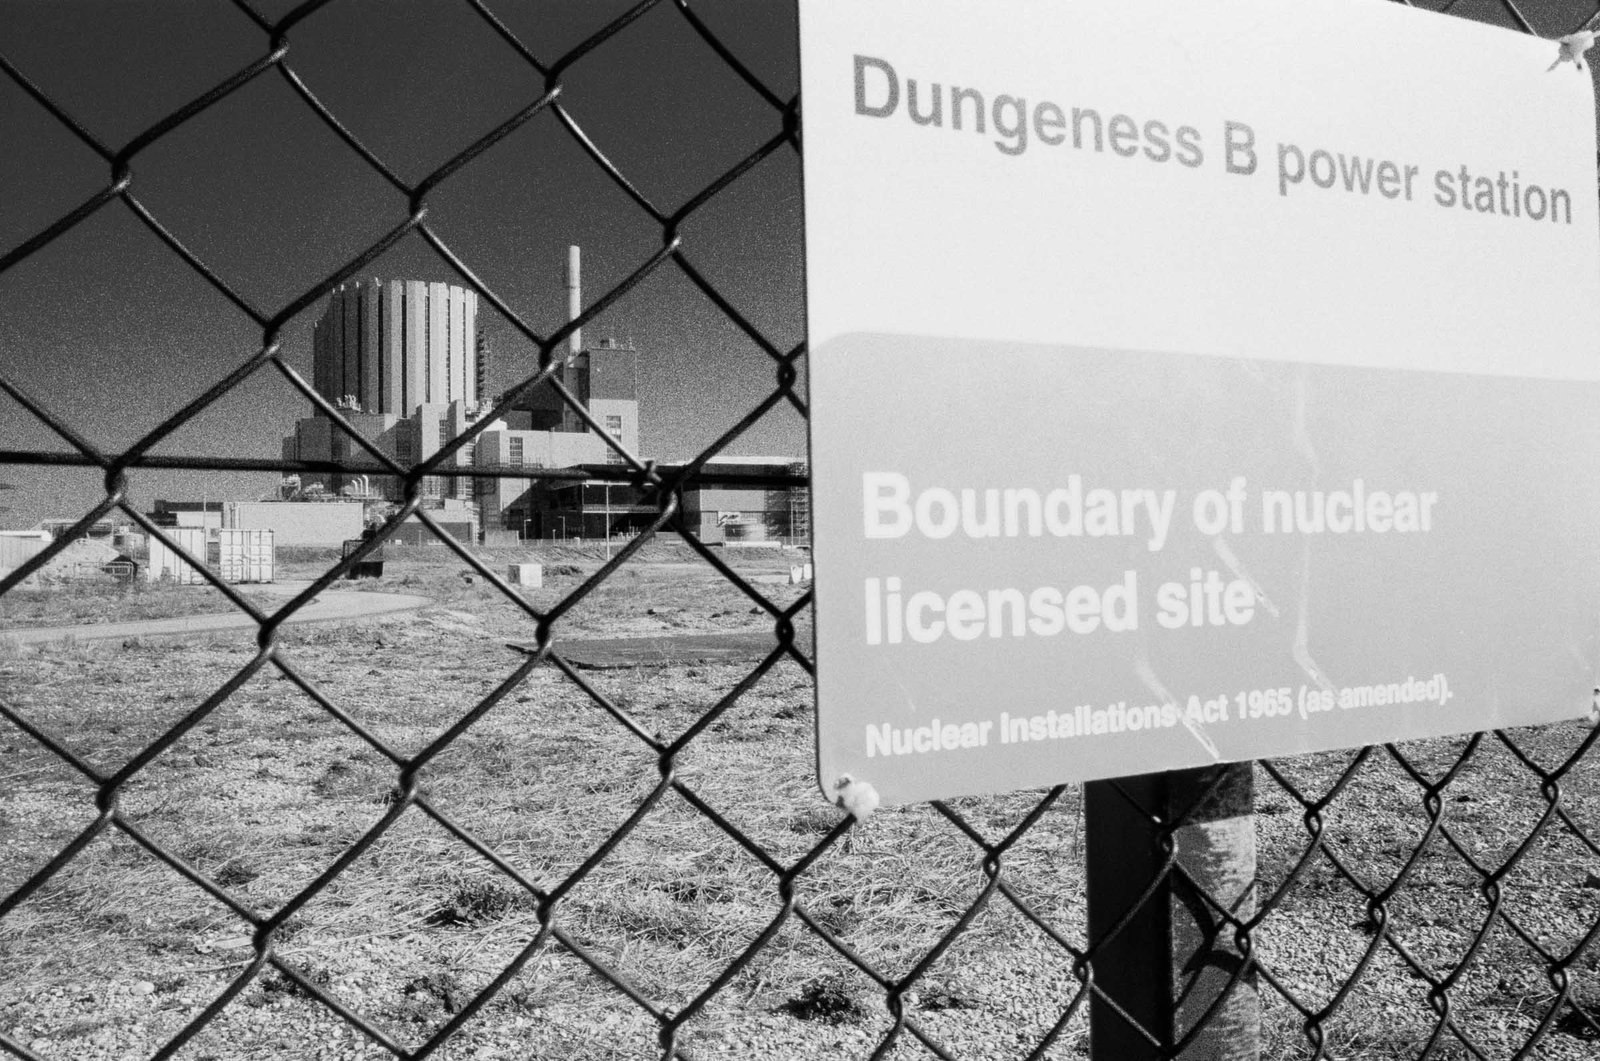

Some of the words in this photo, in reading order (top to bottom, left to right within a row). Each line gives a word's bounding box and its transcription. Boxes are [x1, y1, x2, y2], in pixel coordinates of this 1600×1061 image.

[853, 54, 1204, 168] Dungeness
[1225, 120, 1258, 176] B
[1277, 142, 1419, 200] power
[1434, 164, 1573, 224] station
[862, 472, 1176, 551] Boundary
[1193, 477, 1248, 535] of
[1262, 479, 1439, 533] nuclear
[864, 571, 1138, 645] licensed
[1156, 567, 1255, 629] site
[866, 719, 991, 757] Nuclear
[1001, 701, 1177, 743] Installations
[1186, 694, 1229, 726] Act
[1236, 688, 1293, 719] 1965
[1299, 685, 1333, 720] (as
[1338, 673, 1453, 706] amended).
